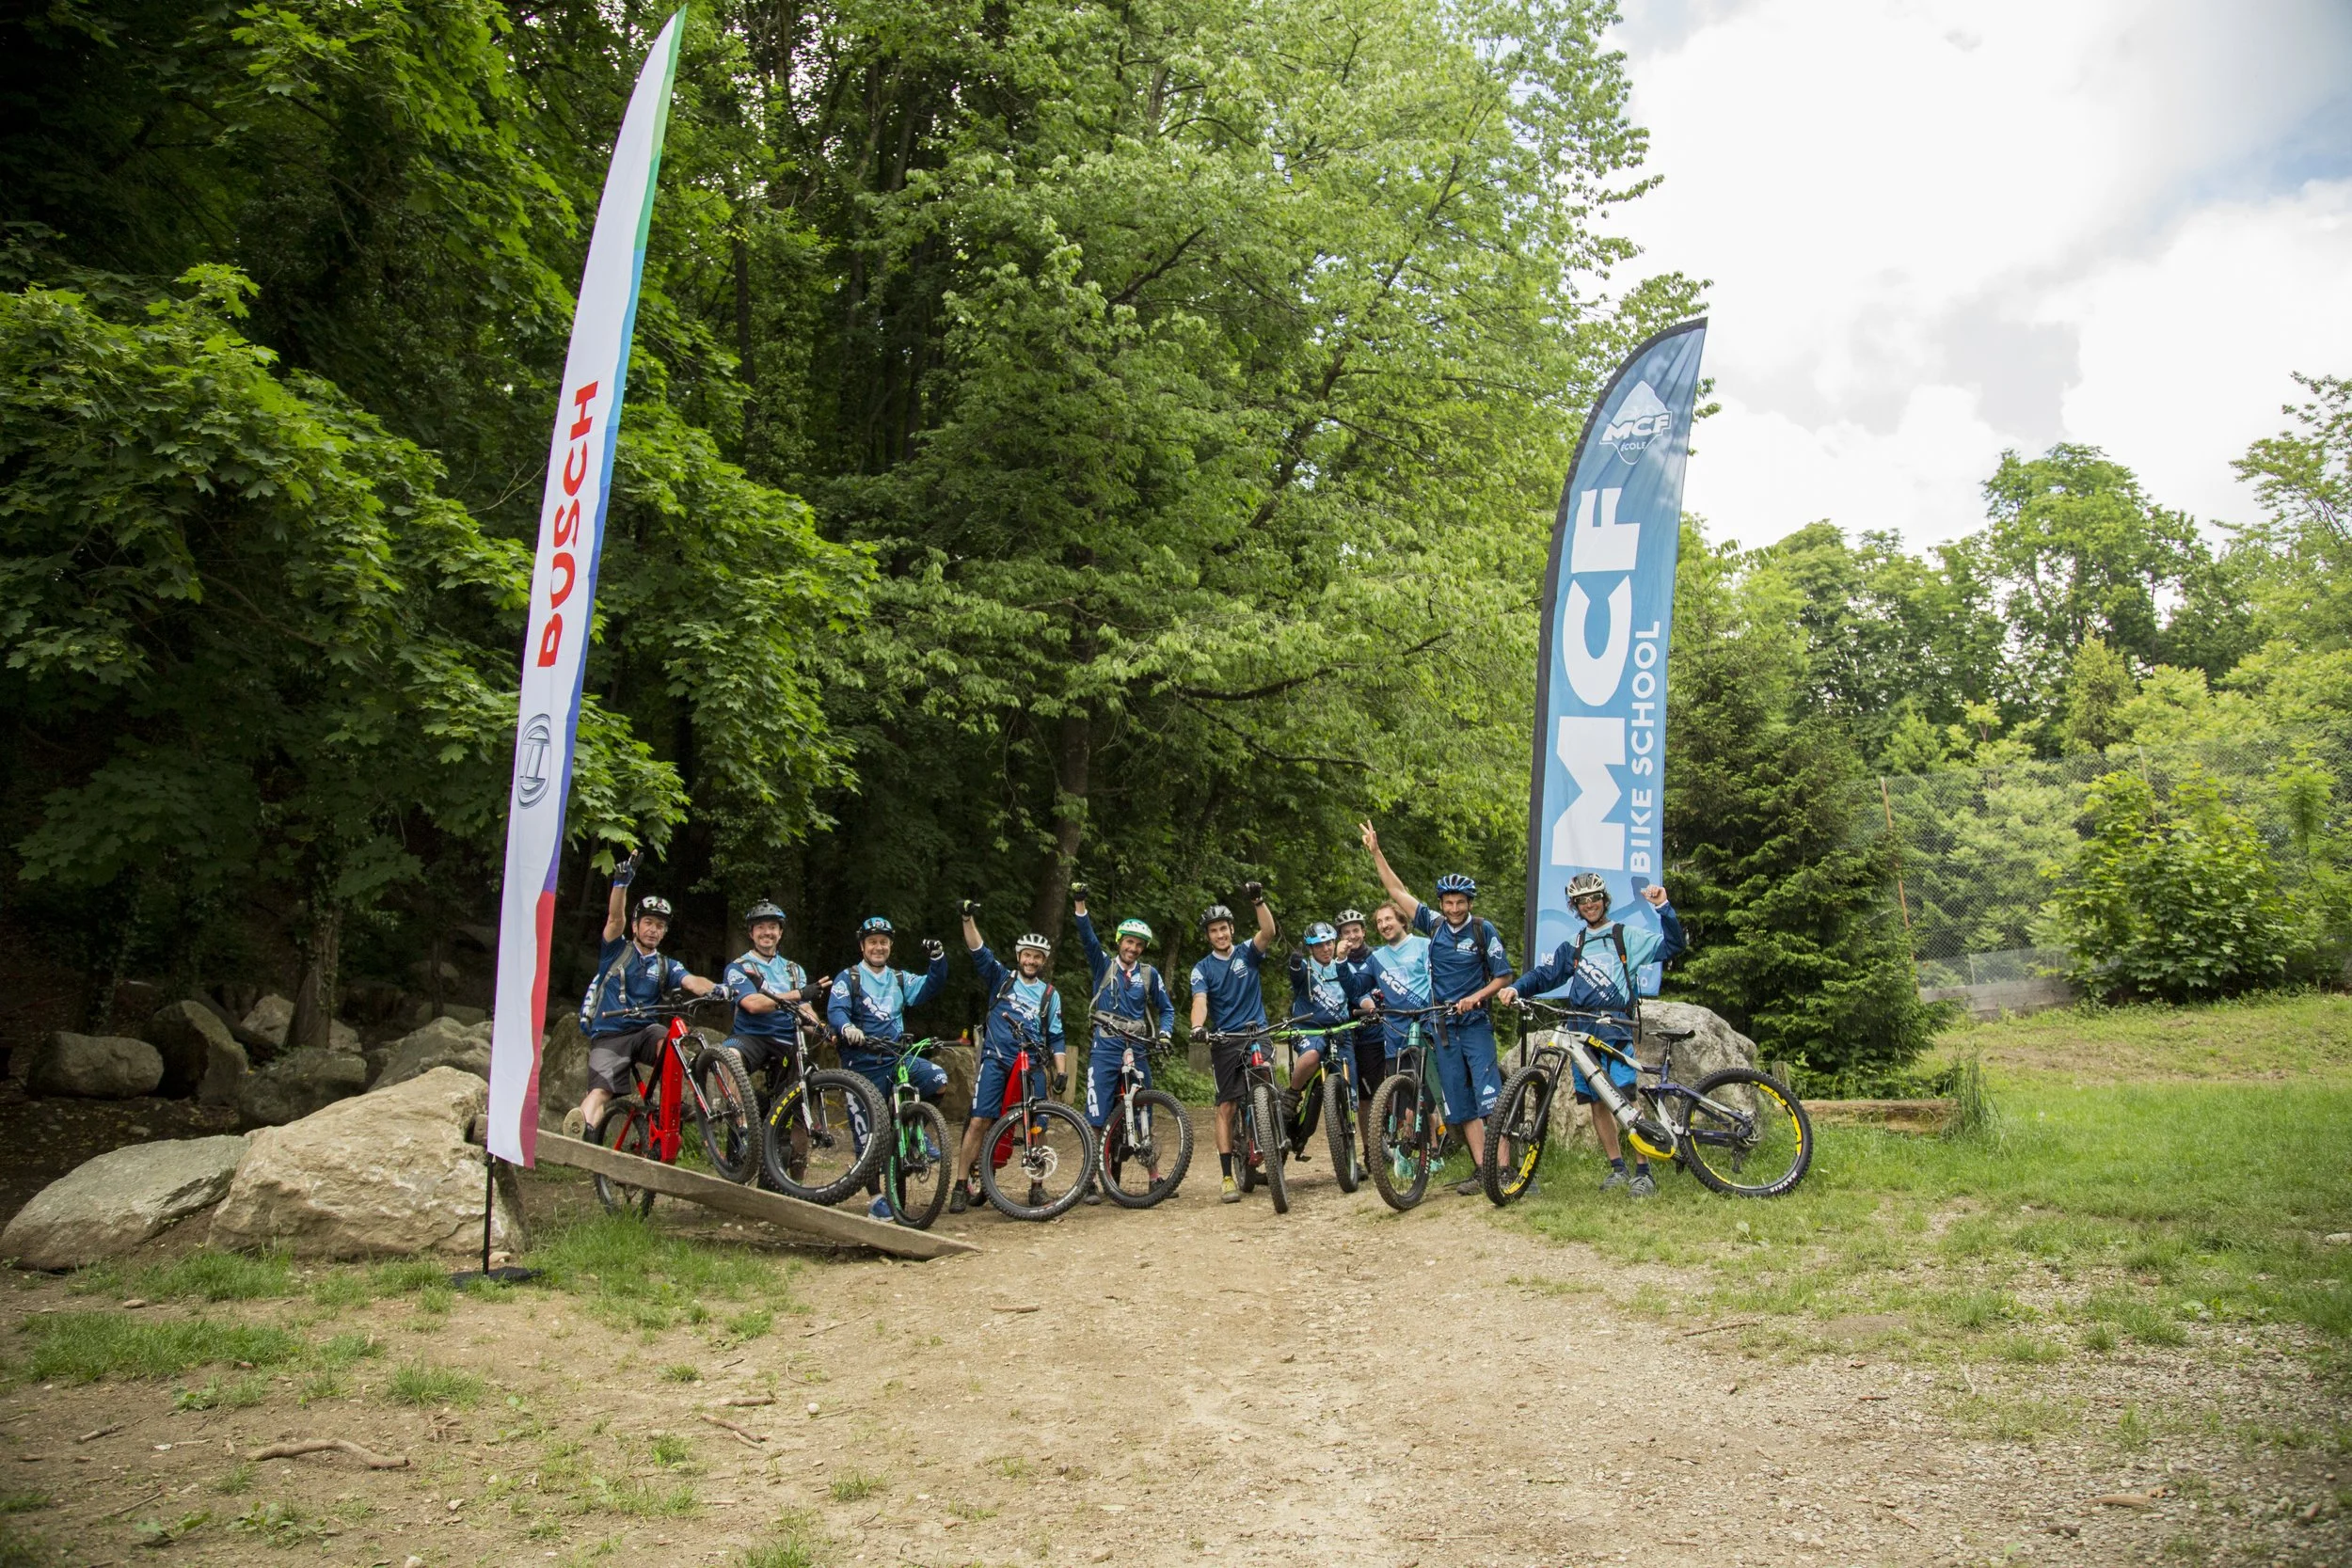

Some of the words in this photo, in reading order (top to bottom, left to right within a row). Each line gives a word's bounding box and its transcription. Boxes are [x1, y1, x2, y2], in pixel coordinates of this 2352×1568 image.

[1601, 414, 1670, 442] MCF
[537, 380, 598, 668] BOSCH
[1551, 487, 1640, 871] MCF
[1630, 620, 1661, 777] SCHOOL
[1629, 788, 1653, 875] BIKE
[1379, 970, 1407, 994] MCF
[1578, 958, 1611, 986] MCF
[771, 1085, 801, 1126] MAXXI
[1088, 1067, 1100, 1117] MCF
[1770, 1171, 1798, 1193] MAXXIS
